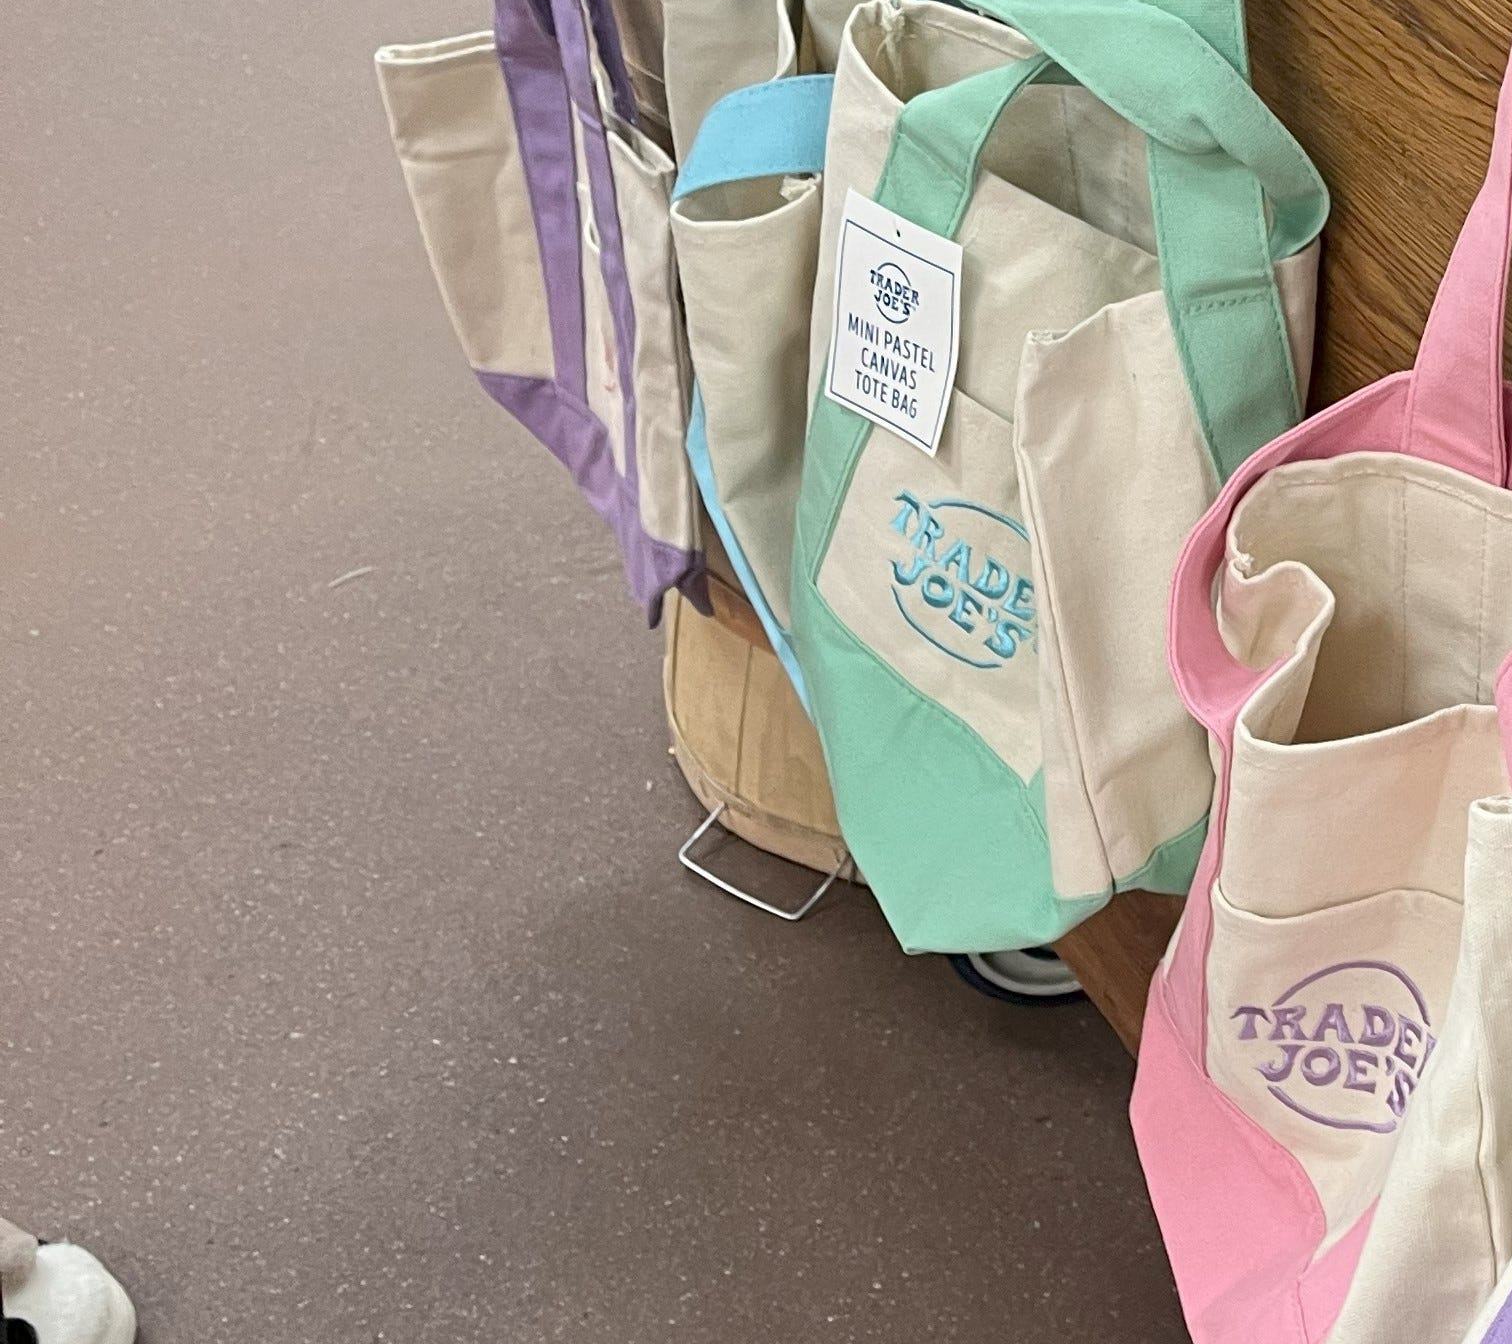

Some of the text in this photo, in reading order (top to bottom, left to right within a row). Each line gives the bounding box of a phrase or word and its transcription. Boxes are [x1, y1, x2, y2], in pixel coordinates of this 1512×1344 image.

[869, 269, 920, 307] TRADER
[873, 289, 911, 317] JOE'S
[847, 311, 936, 374] MINI PASTEL
[861, 346, 918, 391] CANVAS
[854, 368, 918, 420] TOTE BAG
[890, 489, 1037, 622] TRADE
[888, 554, 1033, 660] JOE'S
[1252, 1044, 1417, 1118] JOE'S
